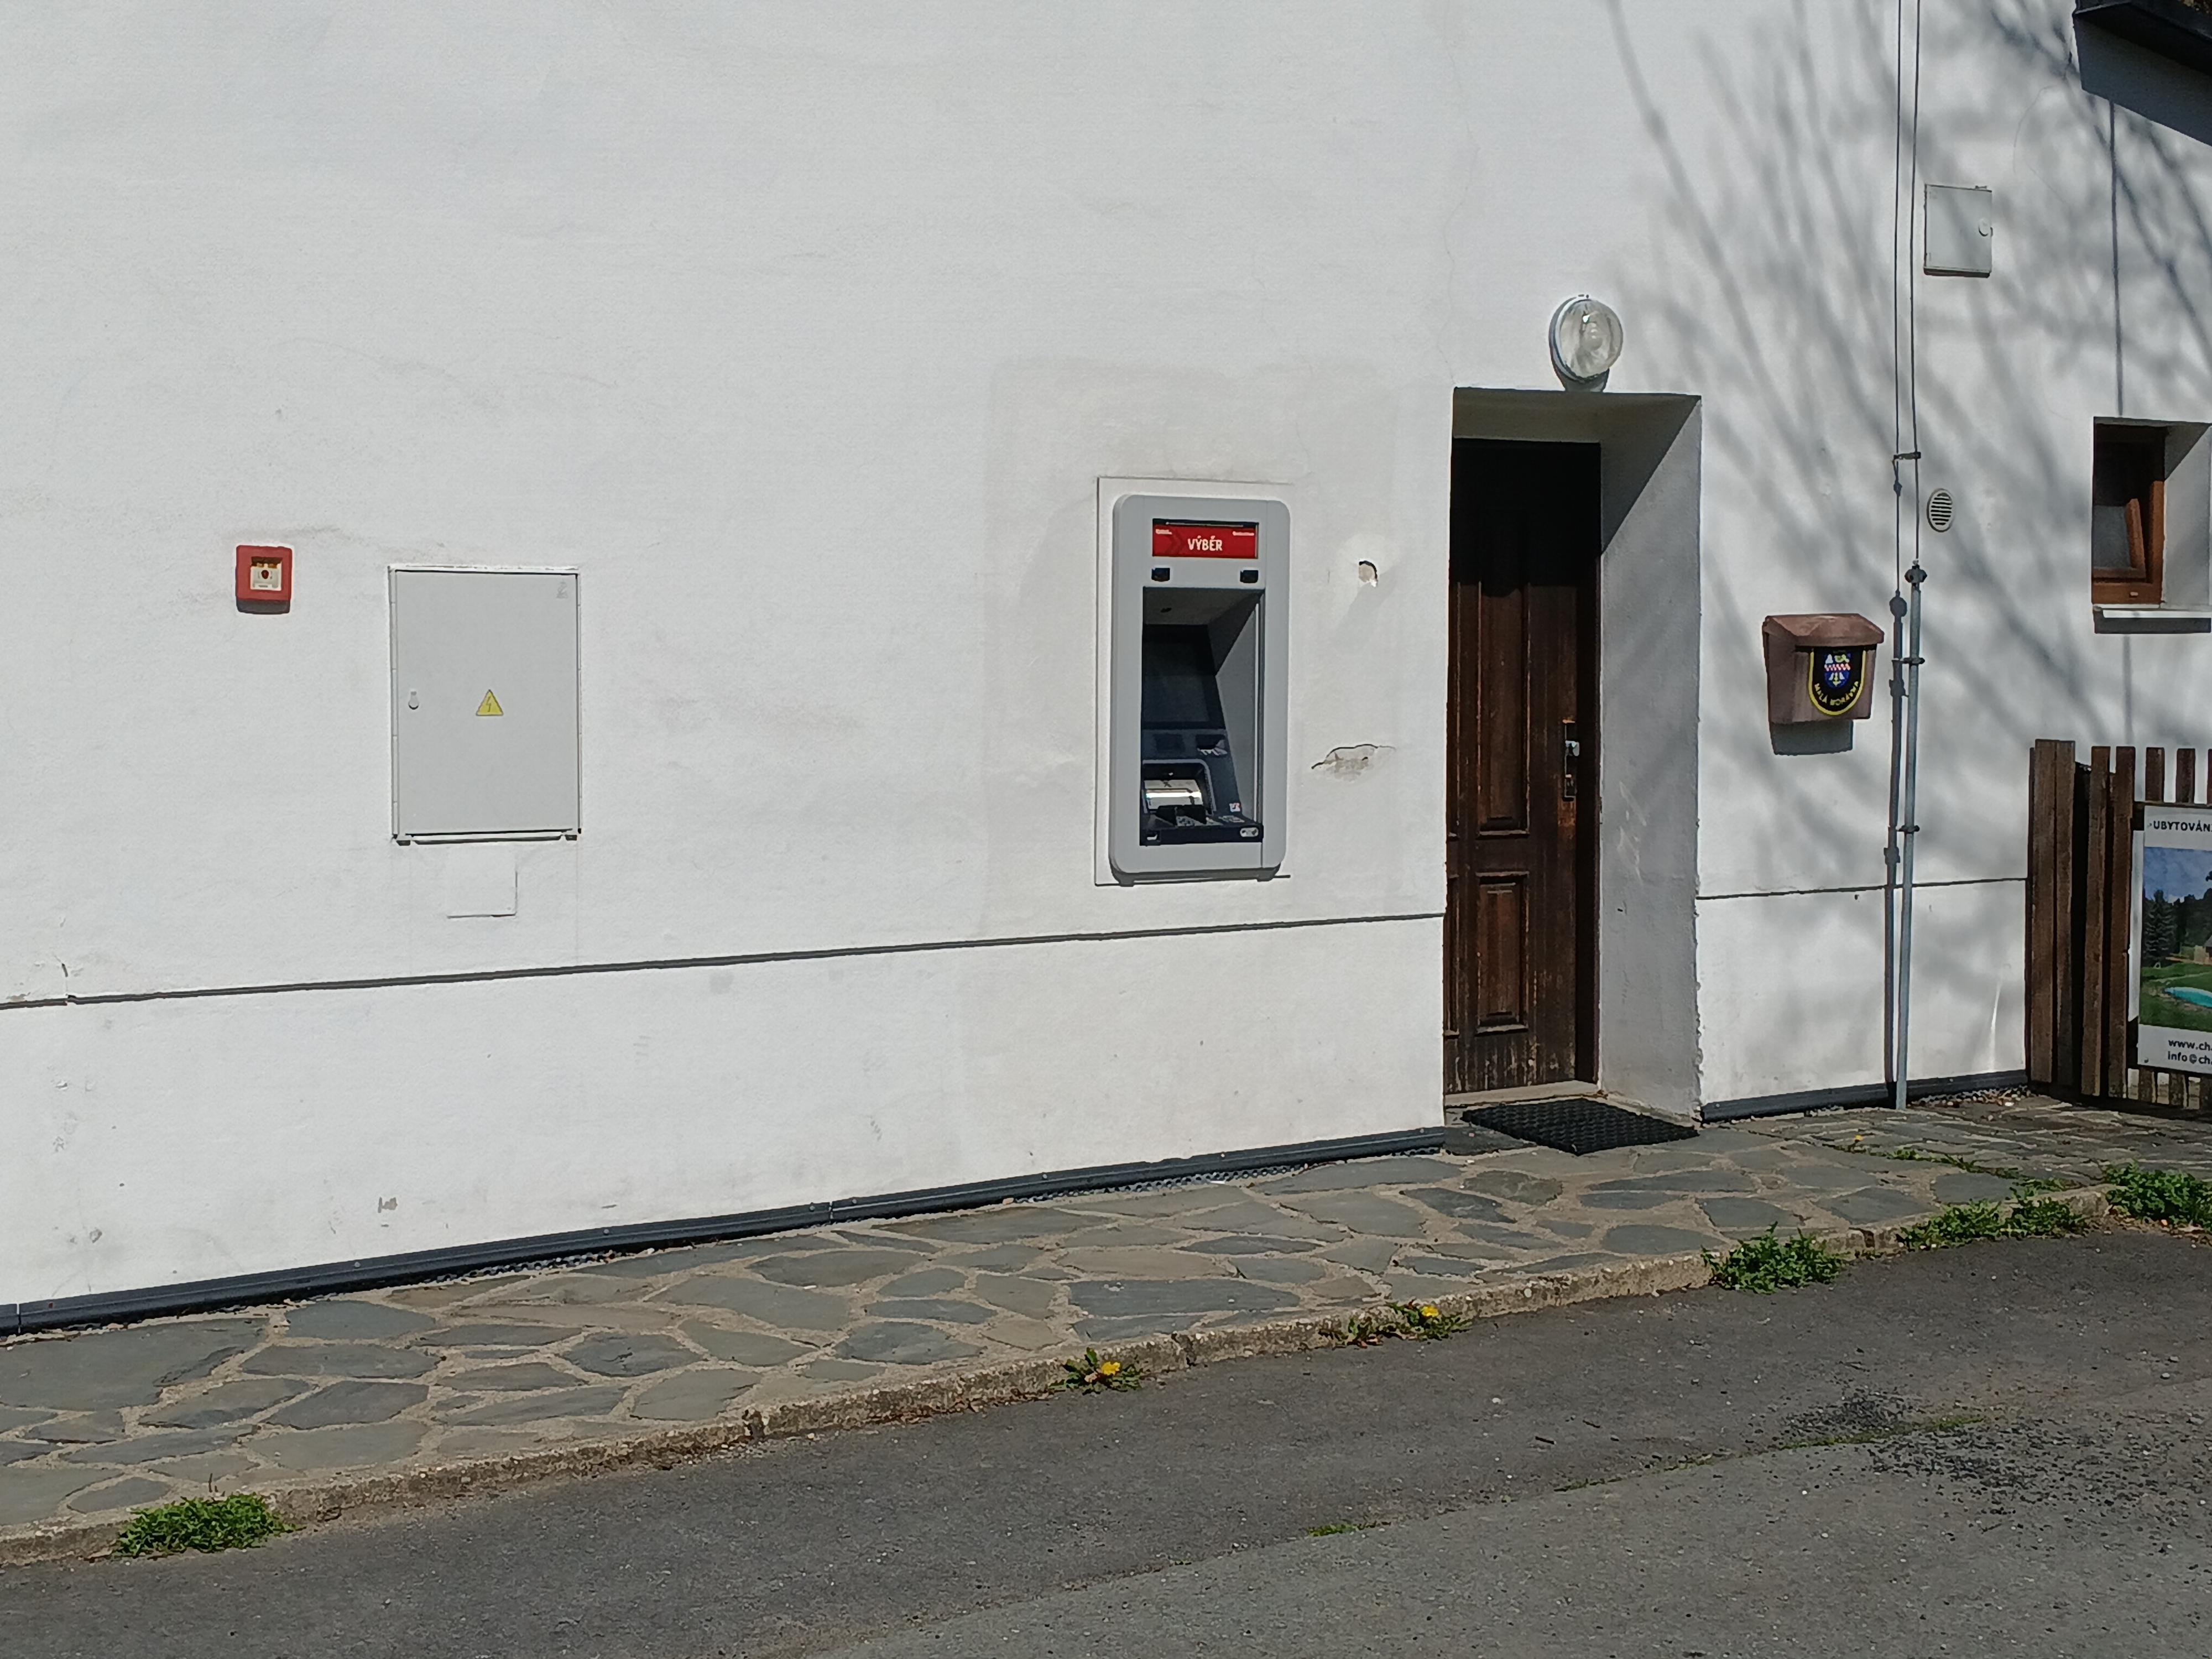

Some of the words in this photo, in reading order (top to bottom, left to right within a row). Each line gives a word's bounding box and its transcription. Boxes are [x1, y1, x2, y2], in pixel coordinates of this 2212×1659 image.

[2153, 820, 2212, 832] UBYTOVÁN
[2168, 1040, 2212, 1051] www.ch
[2167, 1051, 2212, 1065] info@ch
